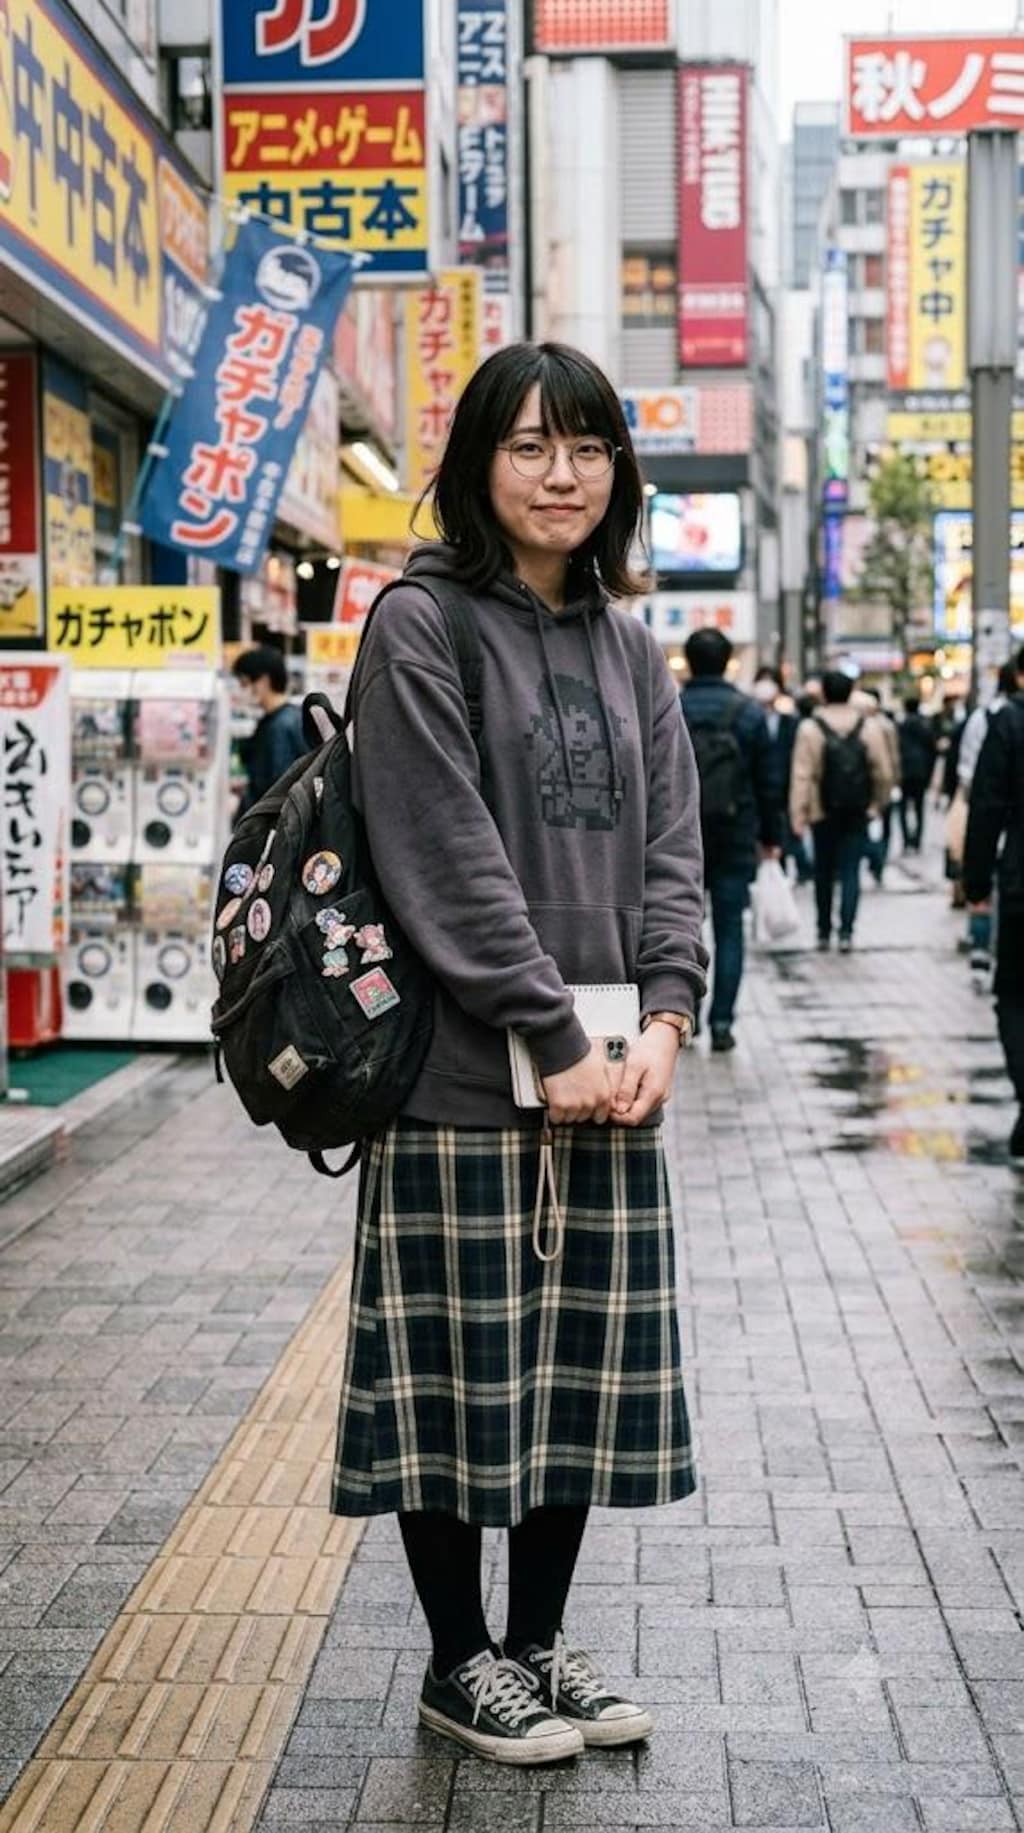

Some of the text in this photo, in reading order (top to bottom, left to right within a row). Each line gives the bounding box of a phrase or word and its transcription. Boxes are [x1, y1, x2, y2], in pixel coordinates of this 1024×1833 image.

[230, 106, 422, 167] アニメ・ゲーム
[238, 179, 419, 241] 中古本
[171, 305, 298, 545] ガチャポン
